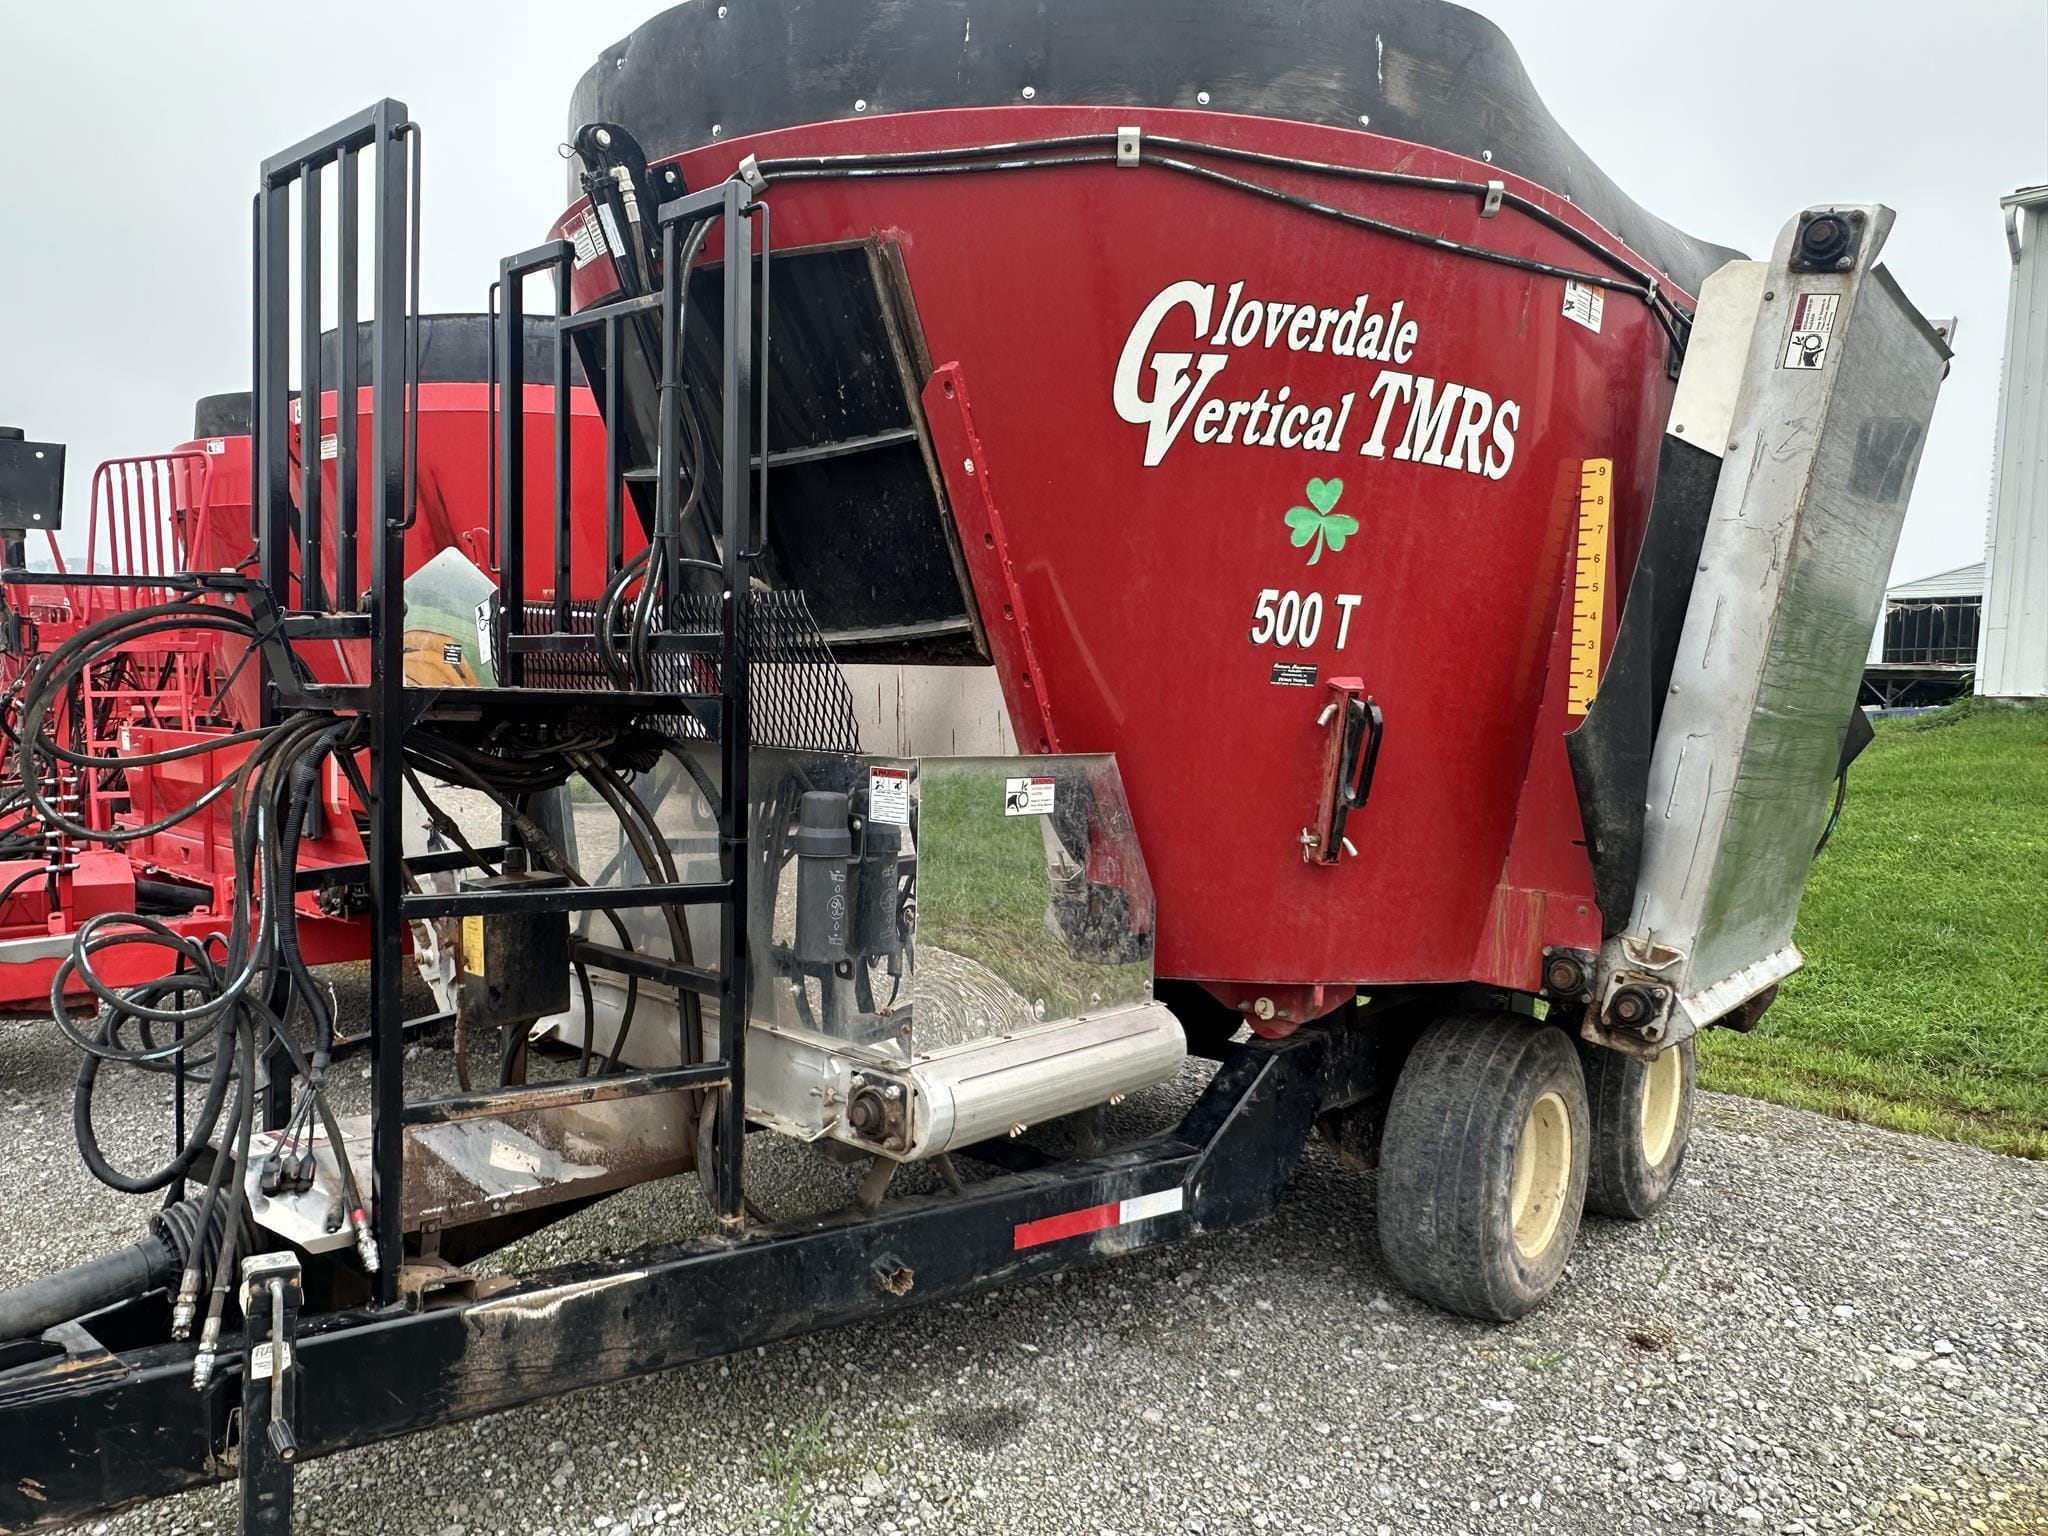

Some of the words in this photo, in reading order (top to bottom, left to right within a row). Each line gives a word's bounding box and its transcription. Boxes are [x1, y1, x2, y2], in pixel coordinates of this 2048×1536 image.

[1113, 280, 1418, 424] Cloverdale
[1142, 352, 1356, 466] Vertical
[1359, 369, 1521, 481] TMRS
[1599, 466, 1606, 477] 9
[1597, 495, 1604, 505] 8
[1597, 524, 1604, 534] 7
[1594, 553, 1601, 563] 6
[1592, 582, 1599, 592] 5
[1250, 588, 1323, 648] 500
[1335, 593, 1362, 650] T
[1589, 611, 1597, 621] 4
[1588, 640, 1595, 650] 3
[1586, 669, 1593, 678] 2
